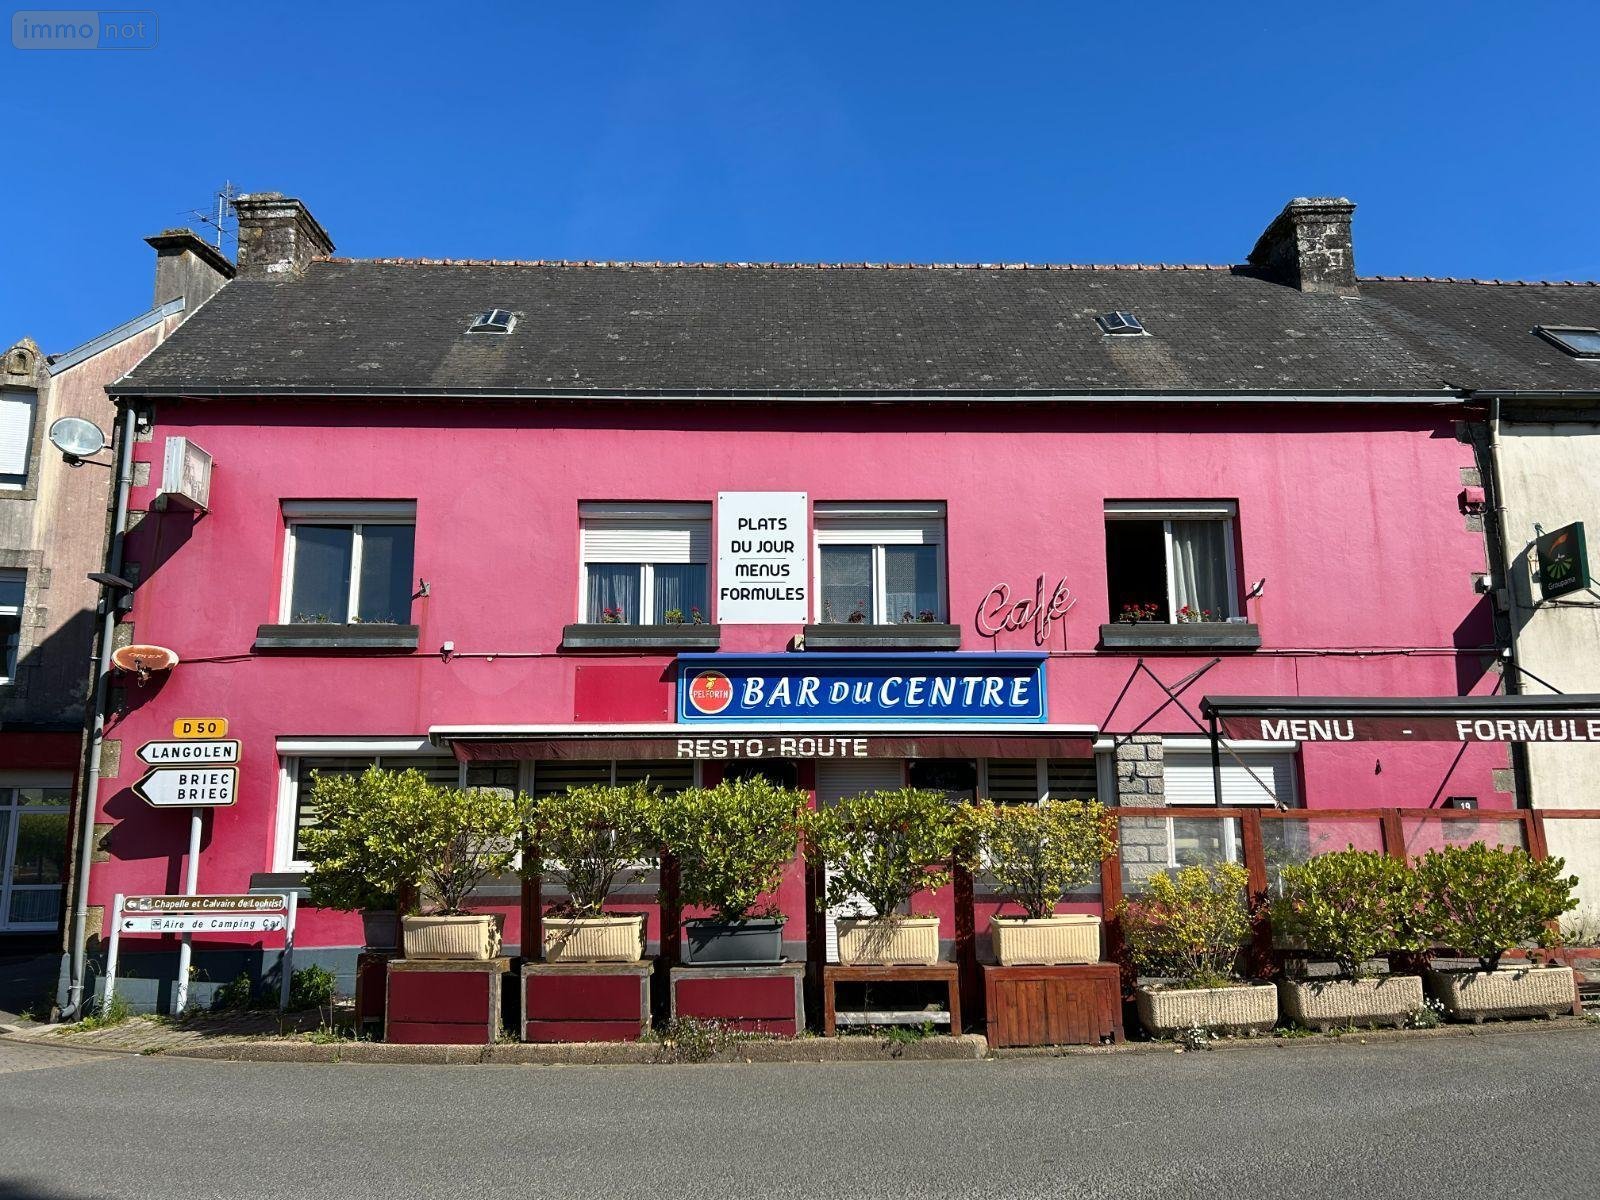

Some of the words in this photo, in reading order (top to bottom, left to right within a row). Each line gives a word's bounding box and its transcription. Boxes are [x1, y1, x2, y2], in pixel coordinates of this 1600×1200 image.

[738, 517, 787, 530] PLATS
[731, 540, 752, 553] DU
[756, 540, 795, 553] JOUR
[735, 564, 790, 577] MENUS
[1547, 576, 1577, 591] Groupama
[720, 587, 805, 600] FORMULES
[978, 572, 1077, 642] Café
[742, 676, 821, 707] BAR
[830, 681, 874, 704] DU
[879, 676, 1031, 707] CENTRE
[183, 723, 192, 733] D
[197, 722, 217, 733] 50
[1259, 719, 1354, 741] MENU
[1455, 719, 1600, 741] FORMULE
[152, 746, 232, 758] LANGOLEN
[179, 774, 229, 785] BRIEC
[177, 788, 228, 799] BRIEG
[1460, 802, 1471, 810] 19
[154, 899, 189, 909] Chapelle
[191, 900, 200, 908] et
[203, 899, 236, 908] Calvaire
[238, 899, 248, 908] de
[163, 920, 184, 929] Aire
[192, 920, 203, 928] de
[211, 919, 256, 930] Camping
[262, 918, 281, 929] Car
